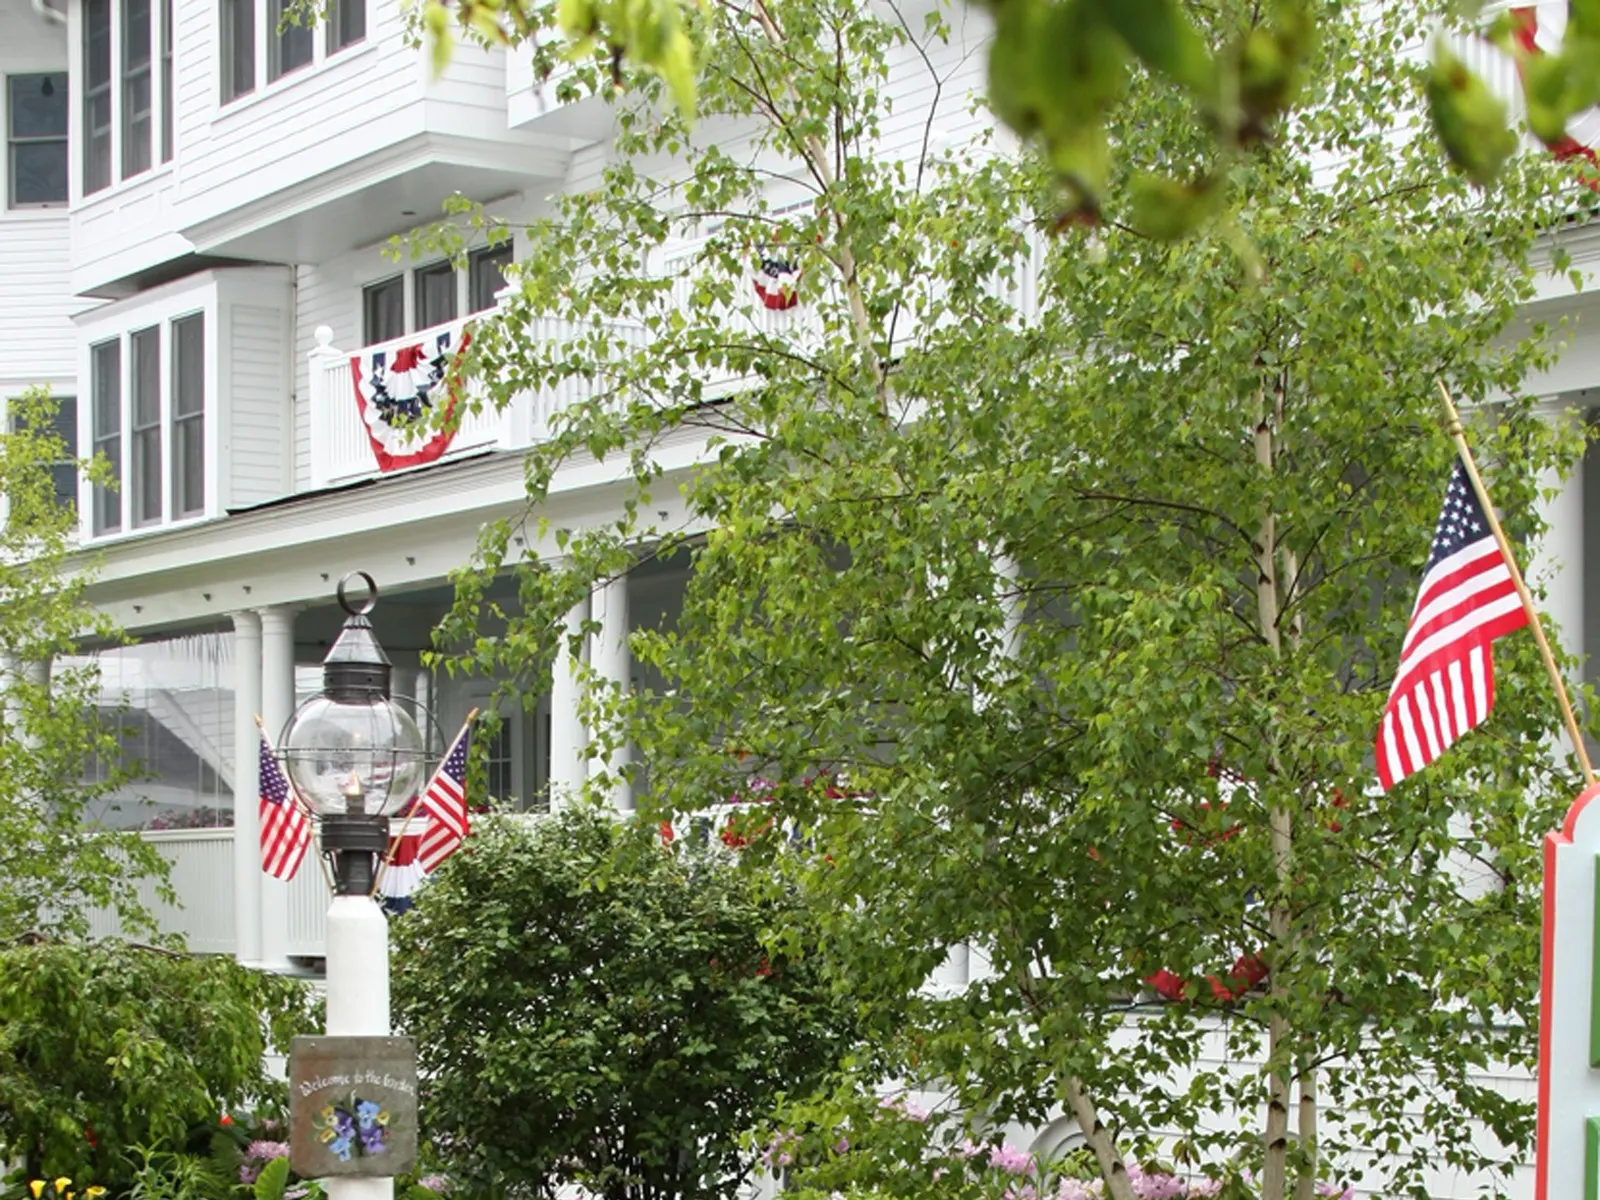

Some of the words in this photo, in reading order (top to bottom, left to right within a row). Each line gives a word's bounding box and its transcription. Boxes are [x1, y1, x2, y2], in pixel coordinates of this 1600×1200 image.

[299, 1074, 350, 1097] Welcome
[353, 1068, 364, 1084] to
[365, 1069, 382, 1085] the
